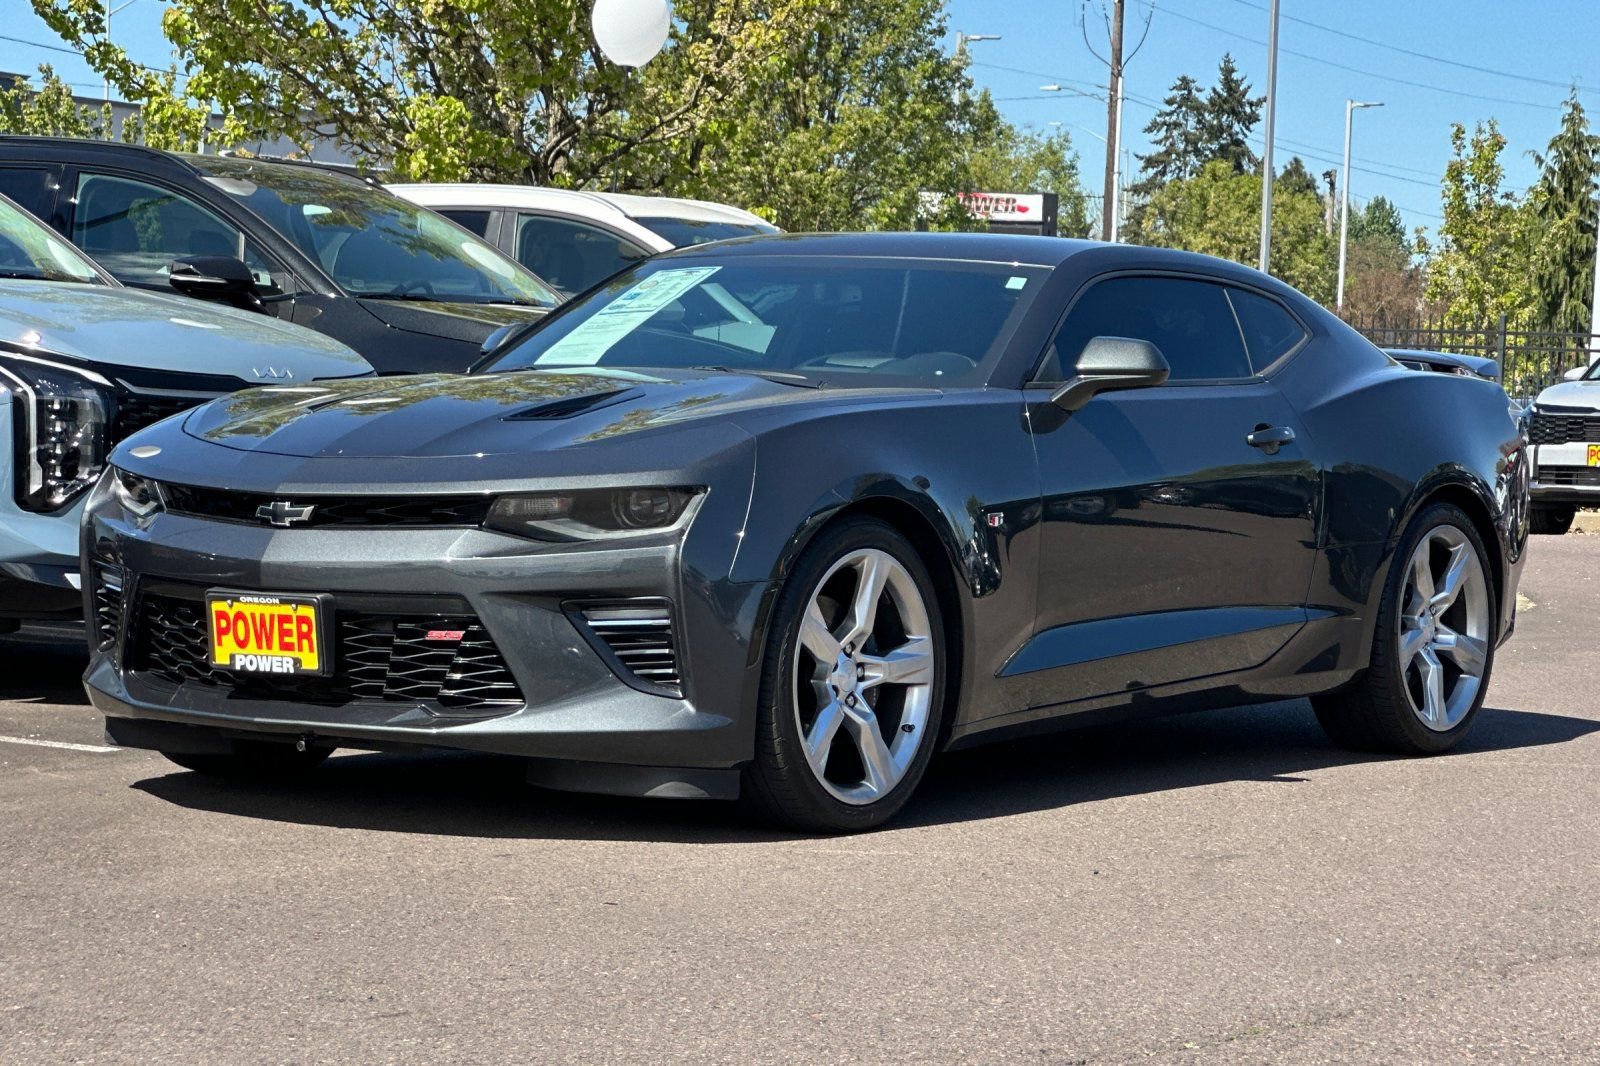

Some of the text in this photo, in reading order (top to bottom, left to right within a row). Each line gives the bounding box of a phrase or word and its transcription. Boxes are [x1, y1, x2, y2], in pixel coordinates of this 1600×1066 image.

[239, 596, 280, 605] OREGON
[214, 610, 315, 653] POWER
[235, 654, 295, 673] POWER
